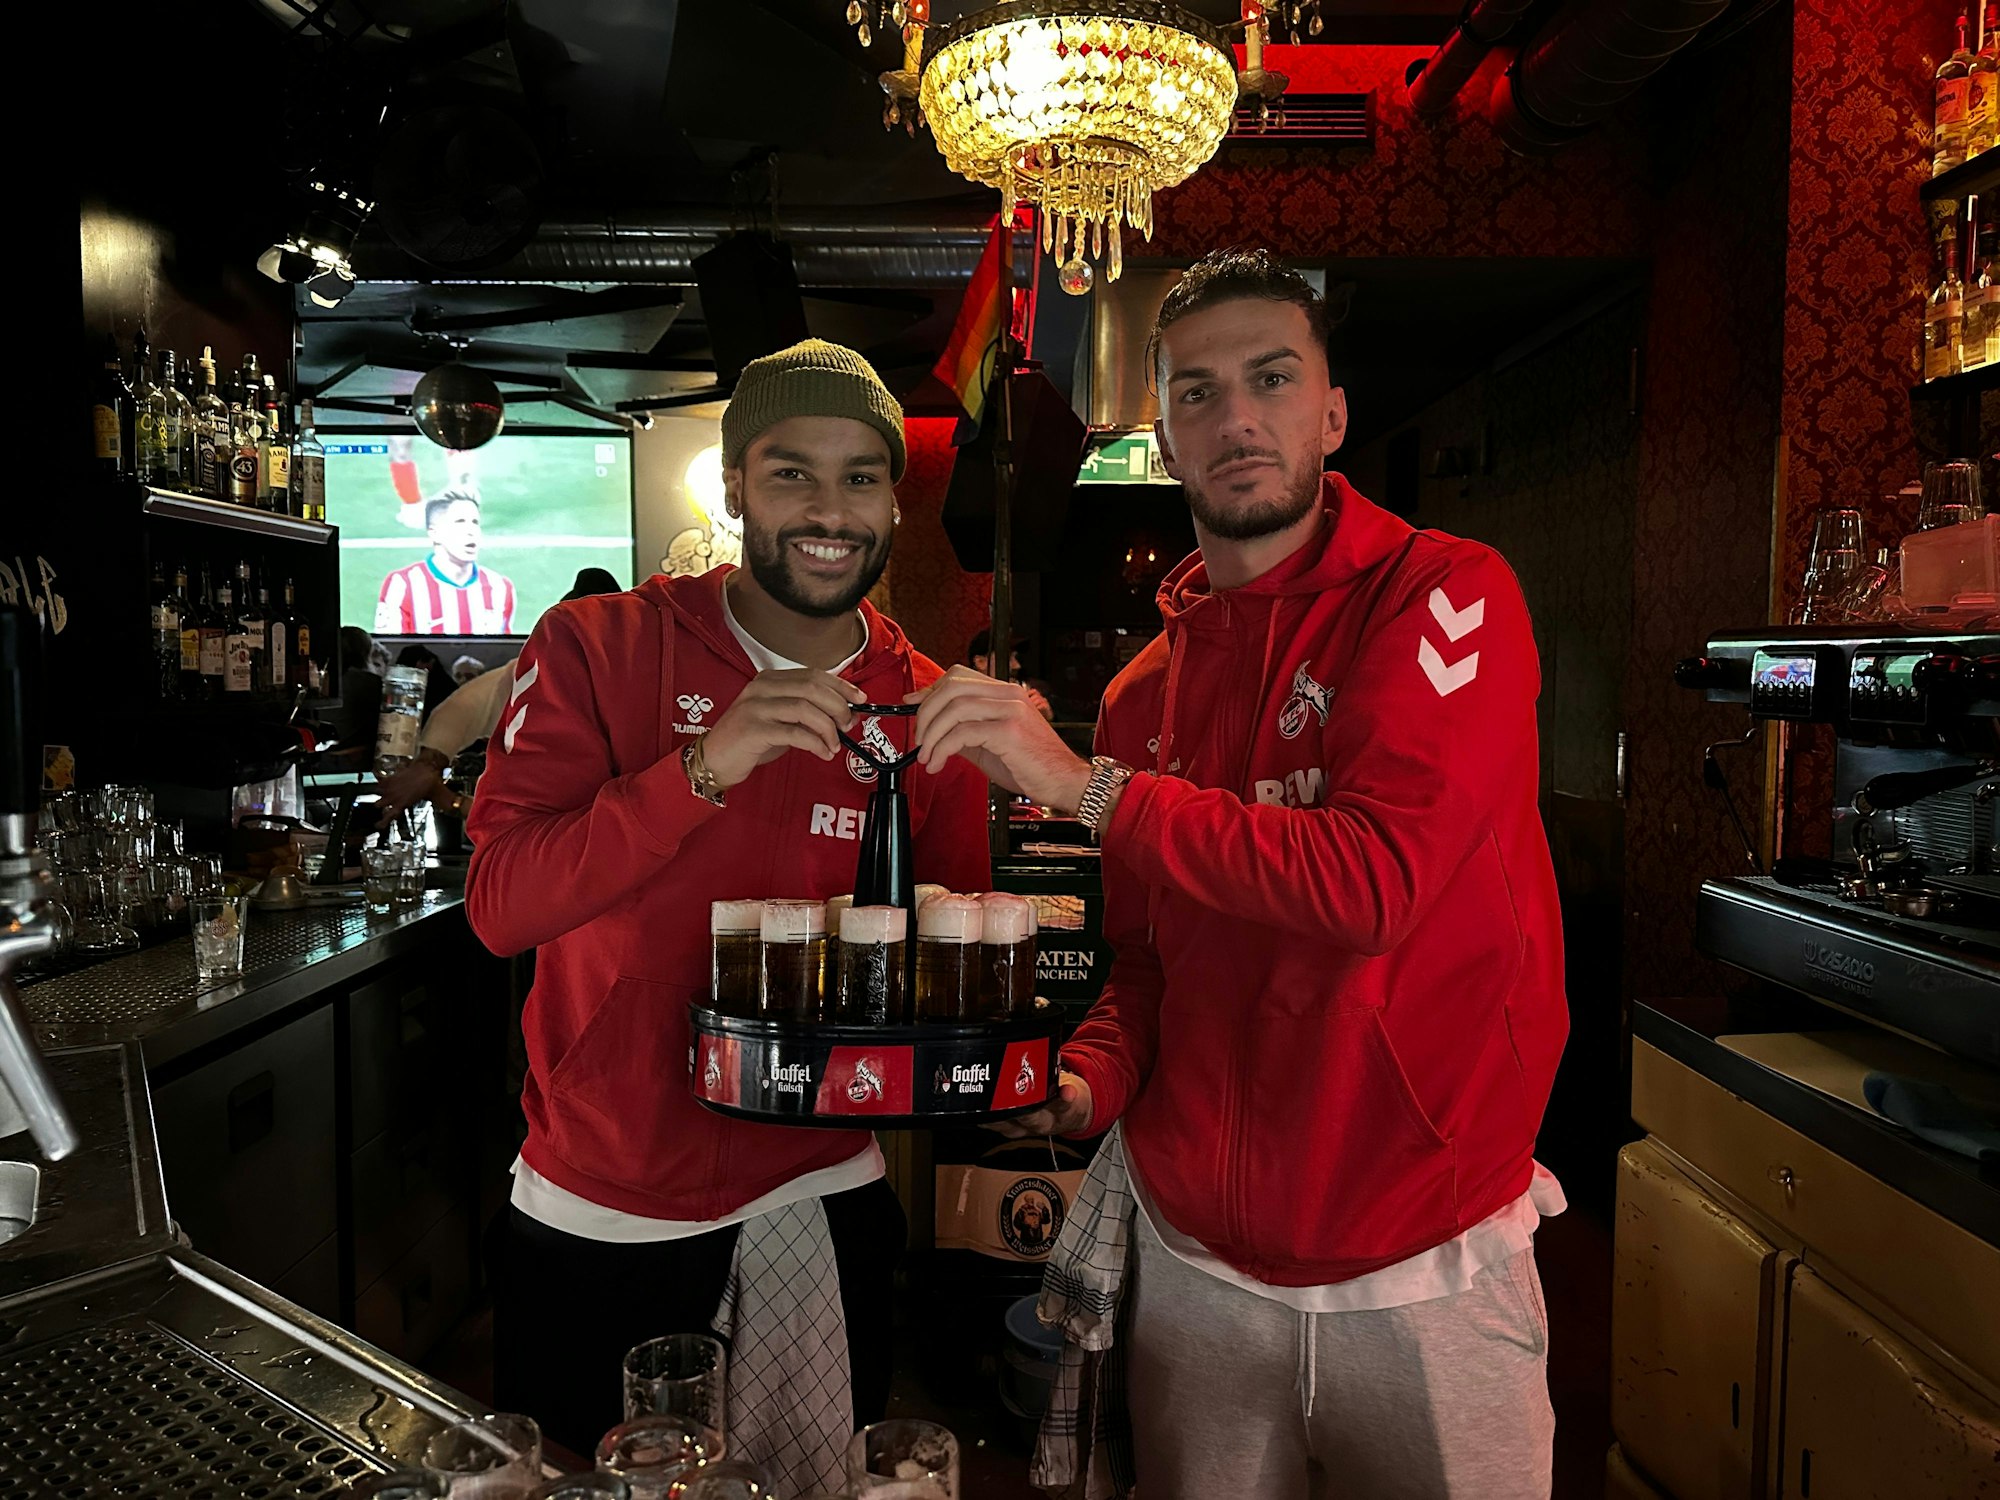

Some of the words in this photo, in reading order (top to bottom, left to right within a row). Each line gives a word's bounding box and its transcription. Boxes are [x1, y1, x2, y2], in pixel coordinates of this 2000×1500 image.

[236, 460, 254, 474] 43
[1036, 950, 1095, 968] ATEN
[770, 1064, 812, 1083] Gaffel
[952, 1063, 991, 1083] Gaffel
[778, 1082, 804, 1094] Kölsch
[959, 1082, 984, 1094] Kölsch
